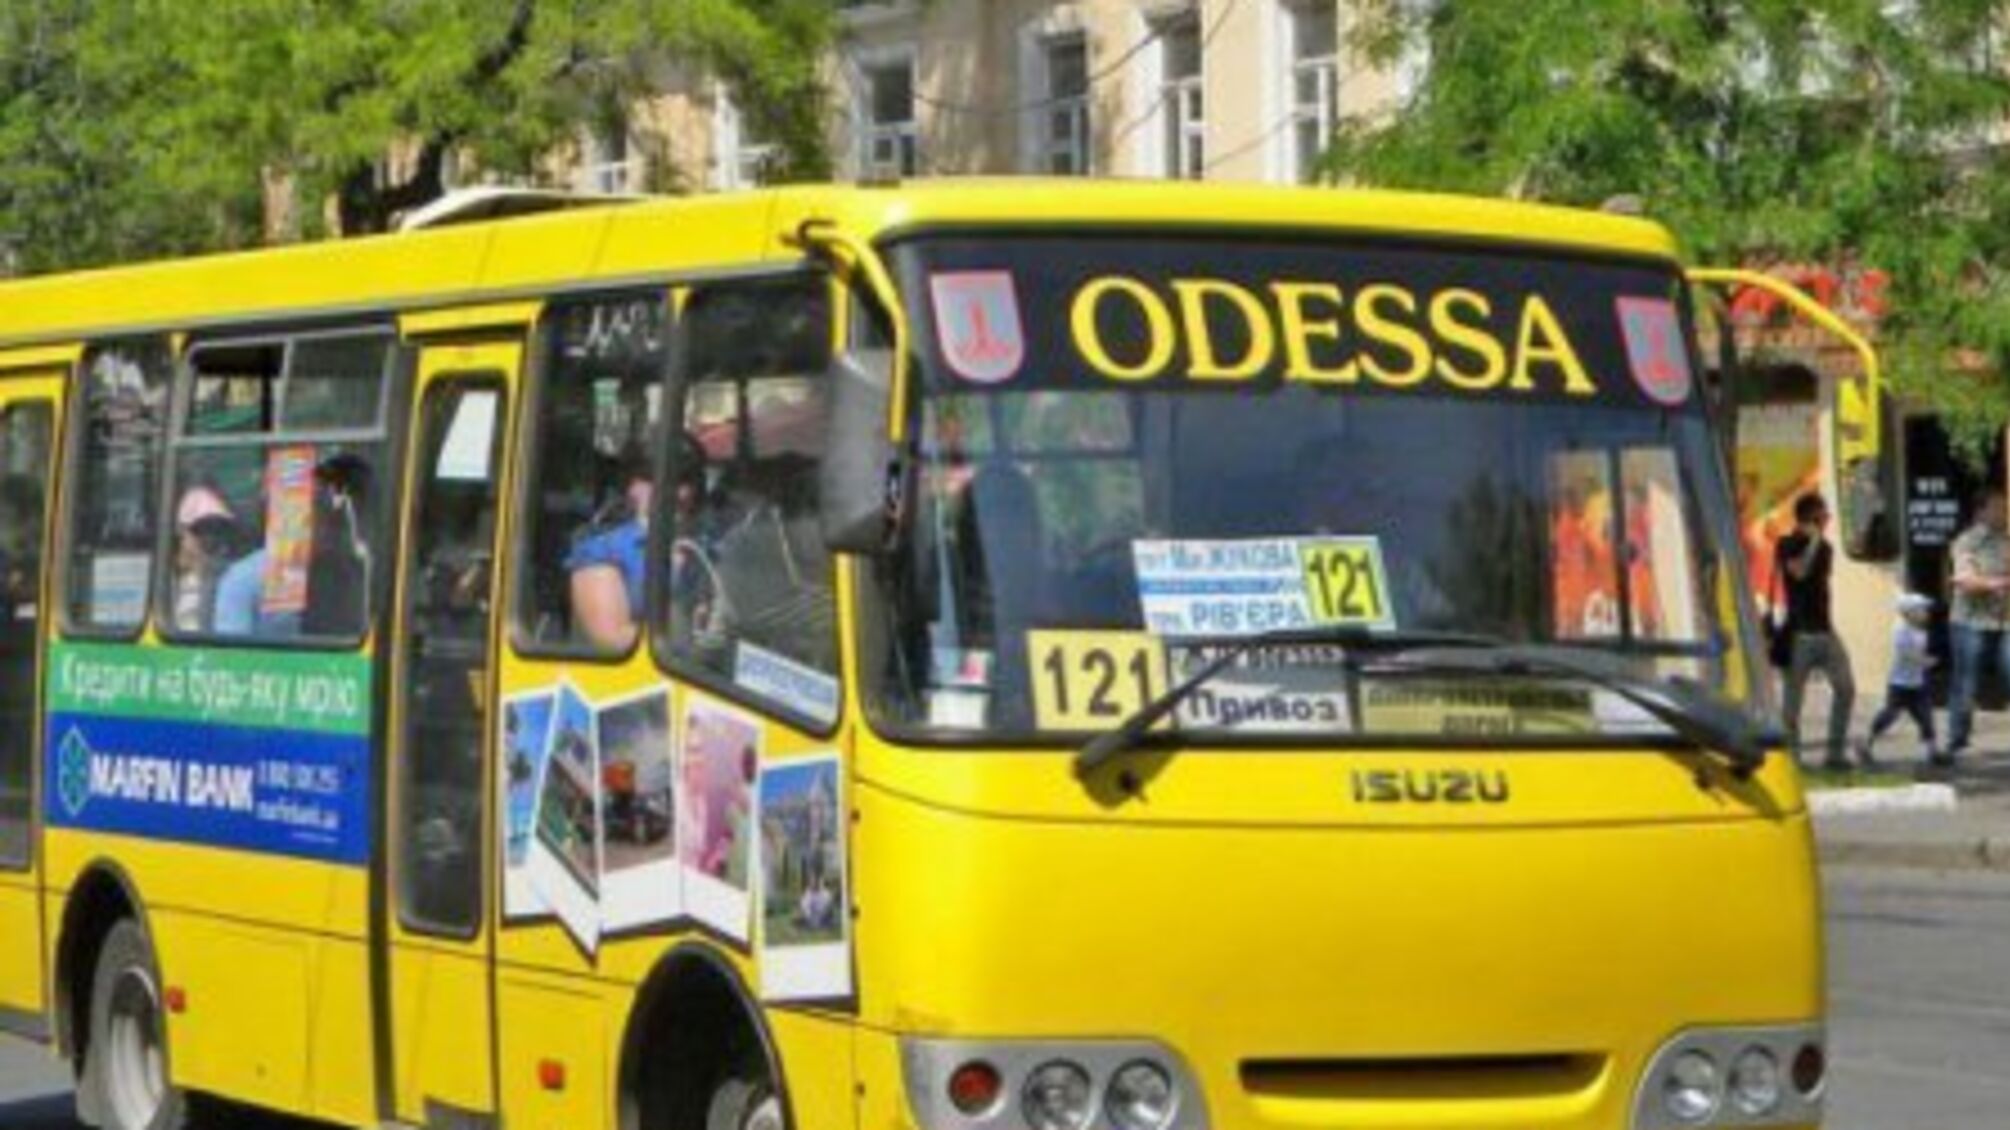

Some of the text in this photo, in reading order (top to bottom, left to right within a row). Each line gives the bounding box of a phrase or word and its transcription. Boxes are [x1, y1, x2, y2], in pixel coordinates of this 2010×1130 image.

[1070, 274, 1597, 394] ODESSA
[1308, 549, 1382, 618] 121
[62, 652, 150, 704] Кредити
[156, 668, 185, 703] на
[1044, 645, 1152, 716] 121
[1189, 689, 1338, 726] Привоз
[89, 752, 181, 803] MARFIN
[185, 763, 254, 812] BANK
[1350, 769, 1510, 803] ISUZU
